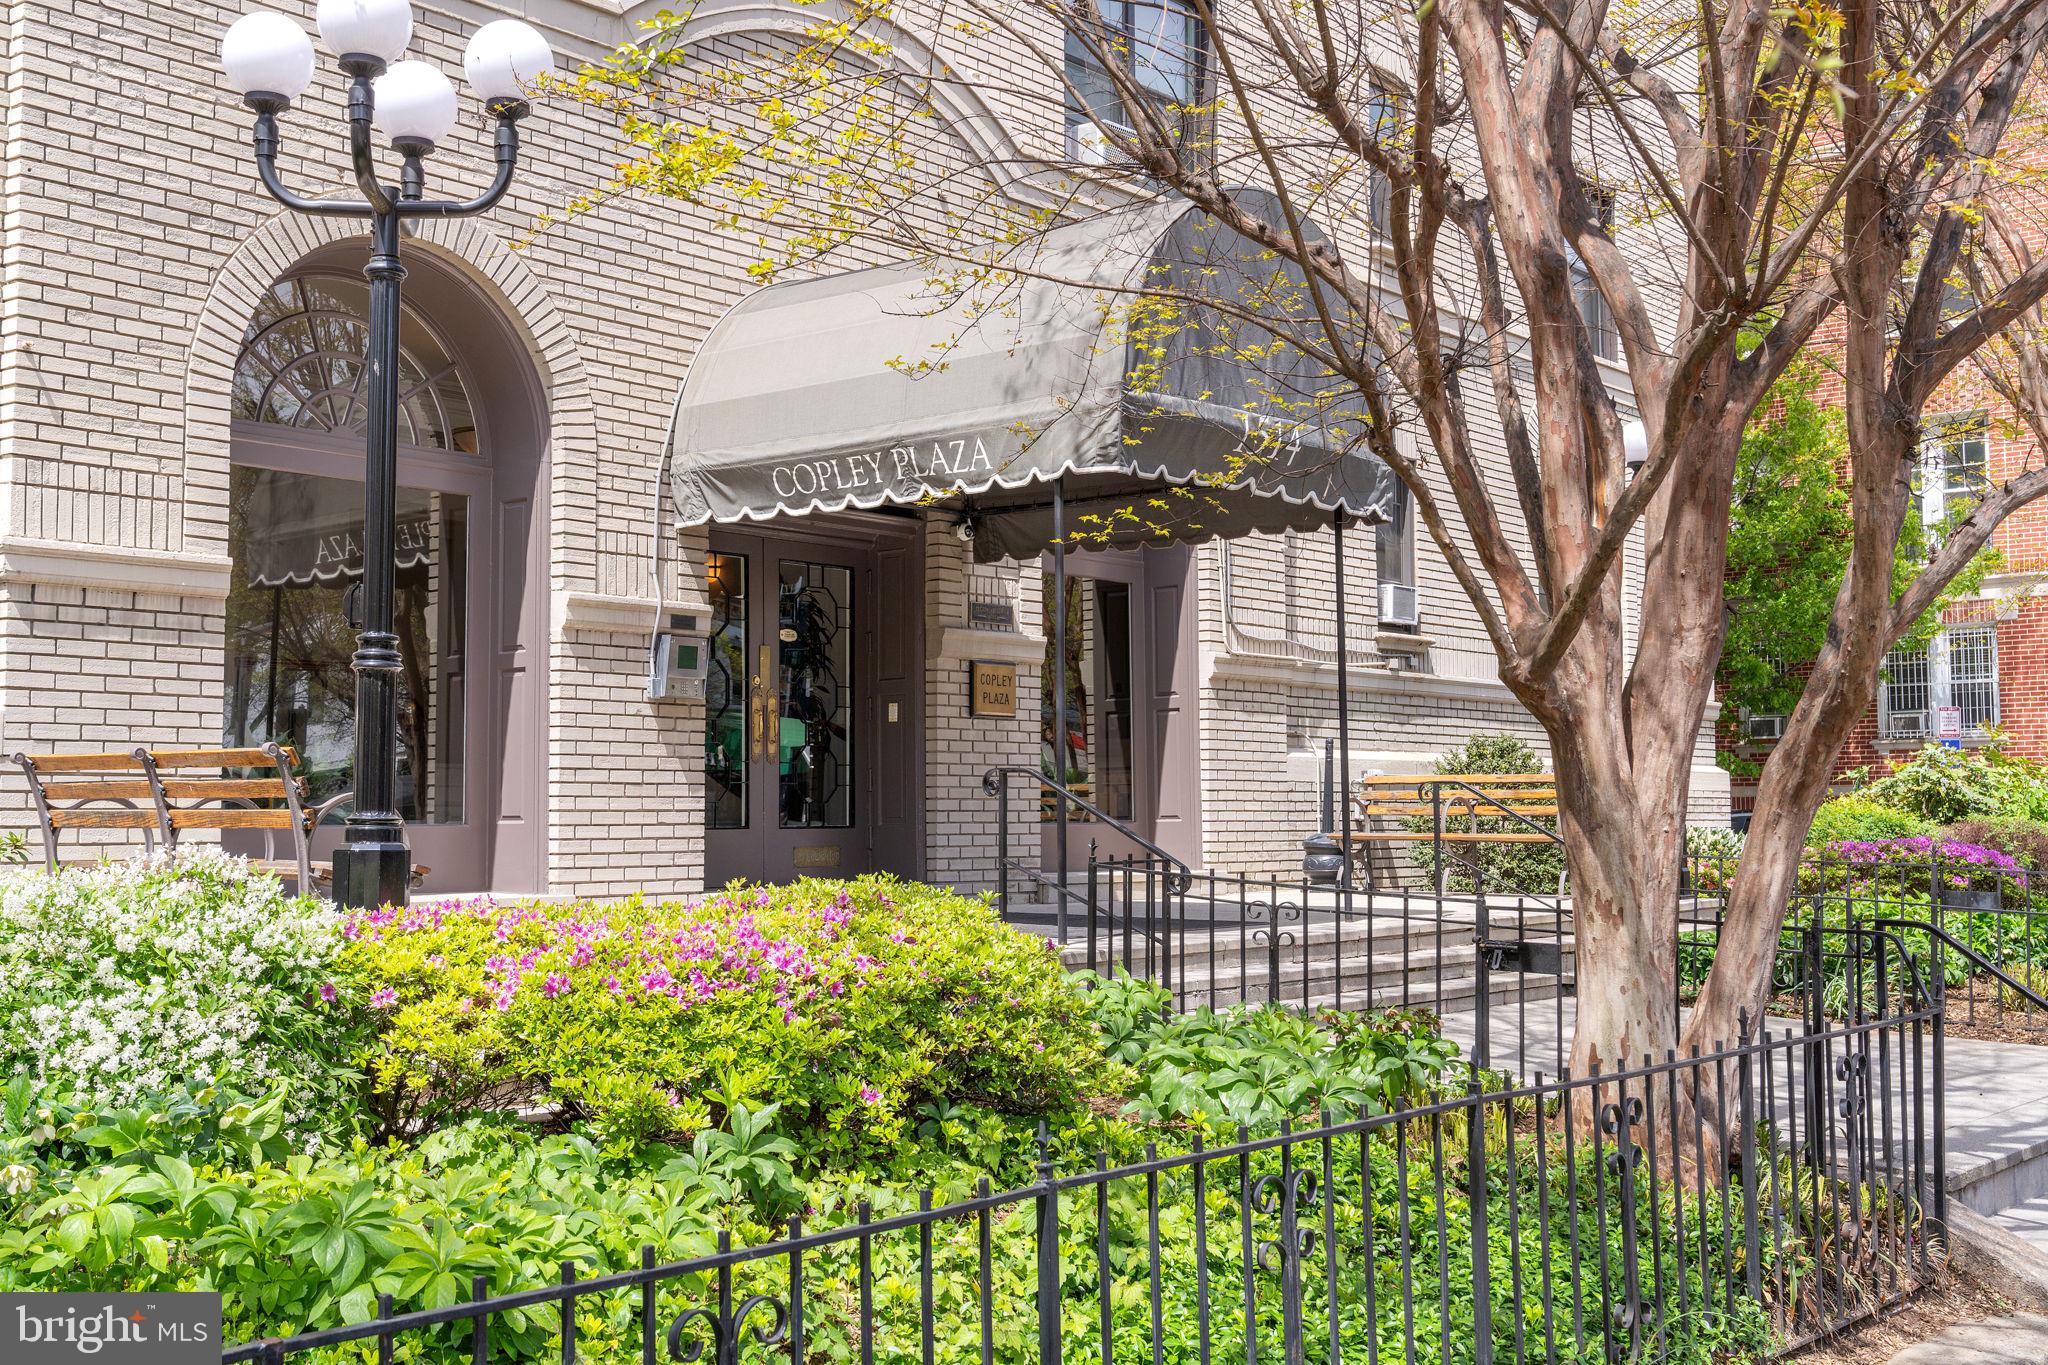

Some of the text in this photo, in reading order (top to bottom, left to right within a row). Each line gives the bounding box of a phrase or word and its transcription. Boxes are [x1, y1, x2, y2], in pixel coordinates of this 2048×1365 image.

[772, 436, 994, 497] COPLEY PLAZA
[980, 673, 1013, 688] COPLEY
[982, 691, 1010, 705] PLAZA
